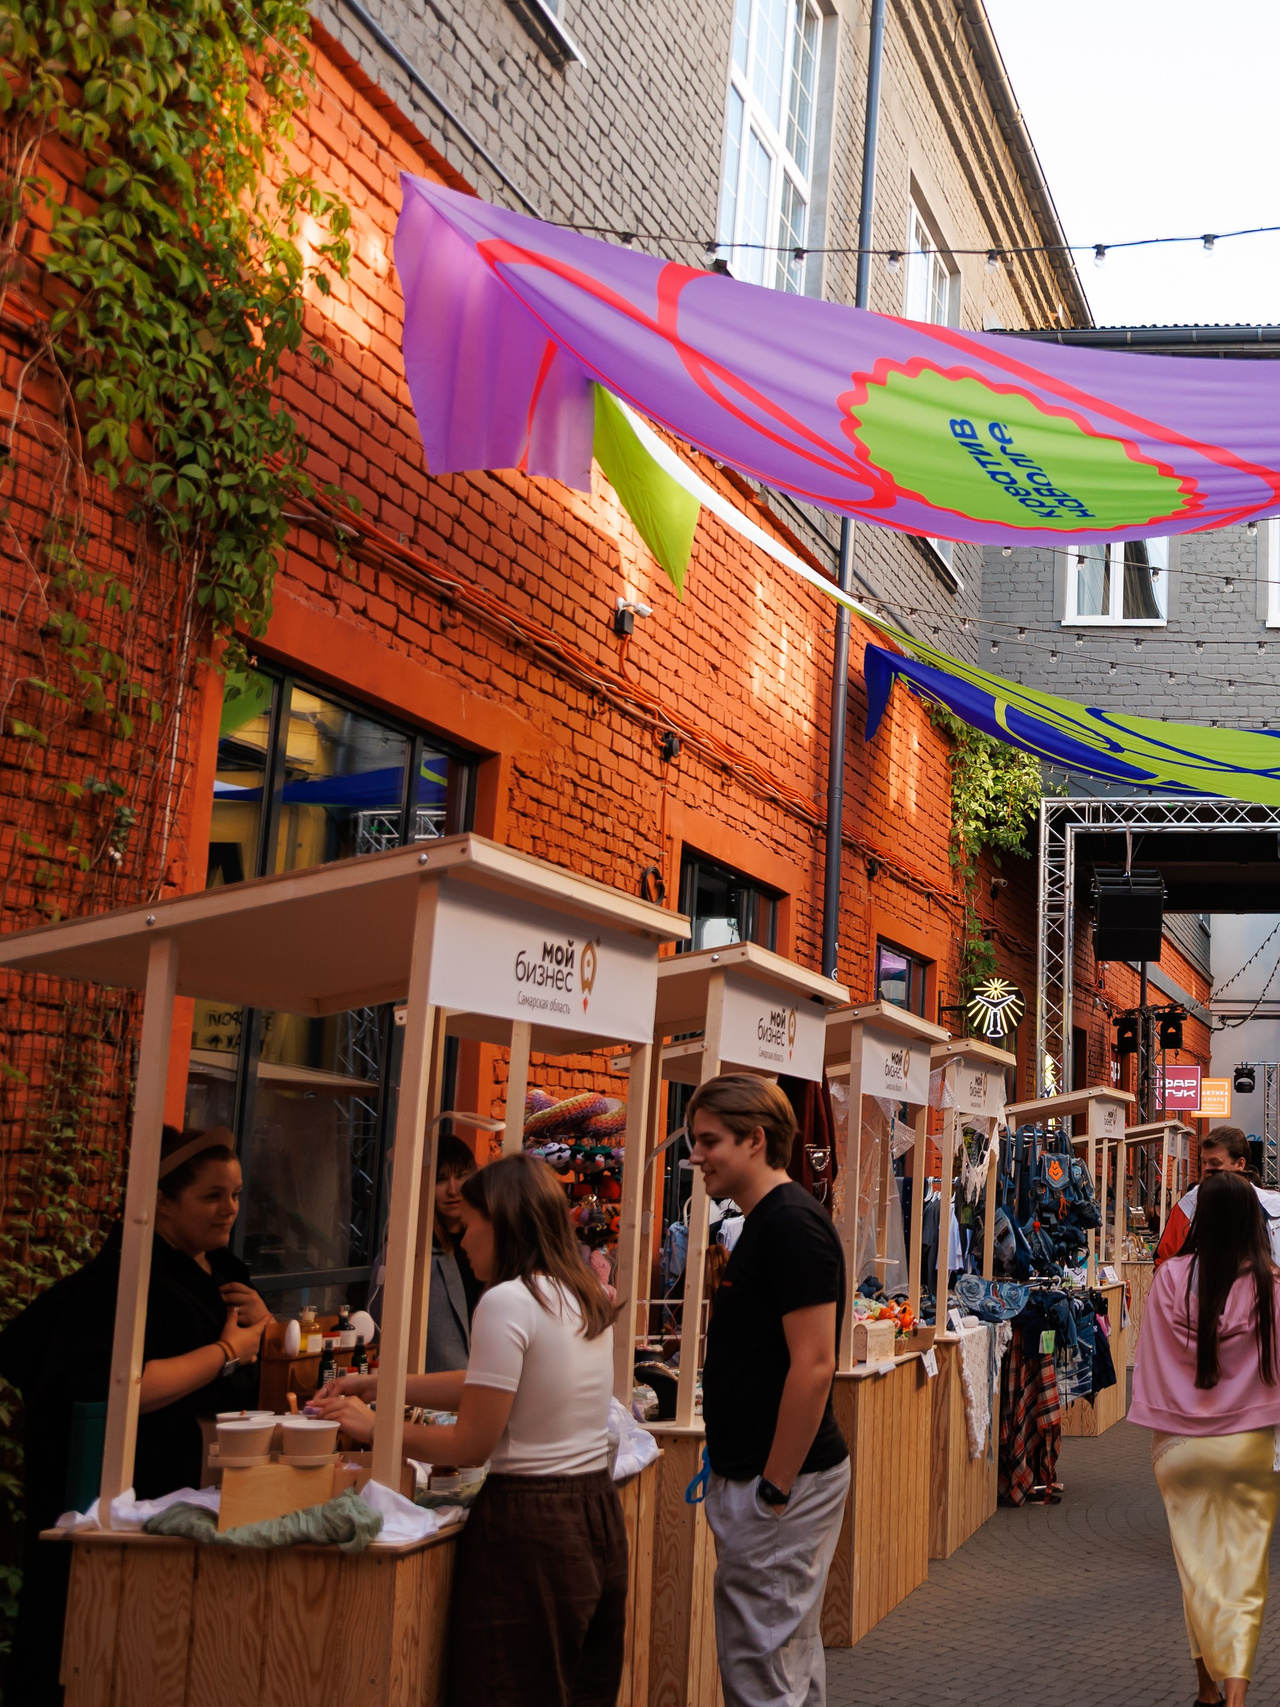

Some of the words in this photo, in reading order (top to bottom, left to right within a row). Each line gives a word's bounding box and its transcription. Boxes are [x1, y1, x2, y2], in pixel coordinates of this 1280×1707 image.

[949, 418, 1063, 518] креатив
[542, 939, 575, 968] мой
[515, 950, 574, 993] бизнес
[517, 991, 549, 1010] Самарская
[550, 998, 571, 1015] область
[770, 1008, 786, 1029] мой
[758, 1017, 785, 1047] бизнес
[1160, 1078, 1197, 1088] ФАР
[1161, 1089, 1197, 1098] ТУК
